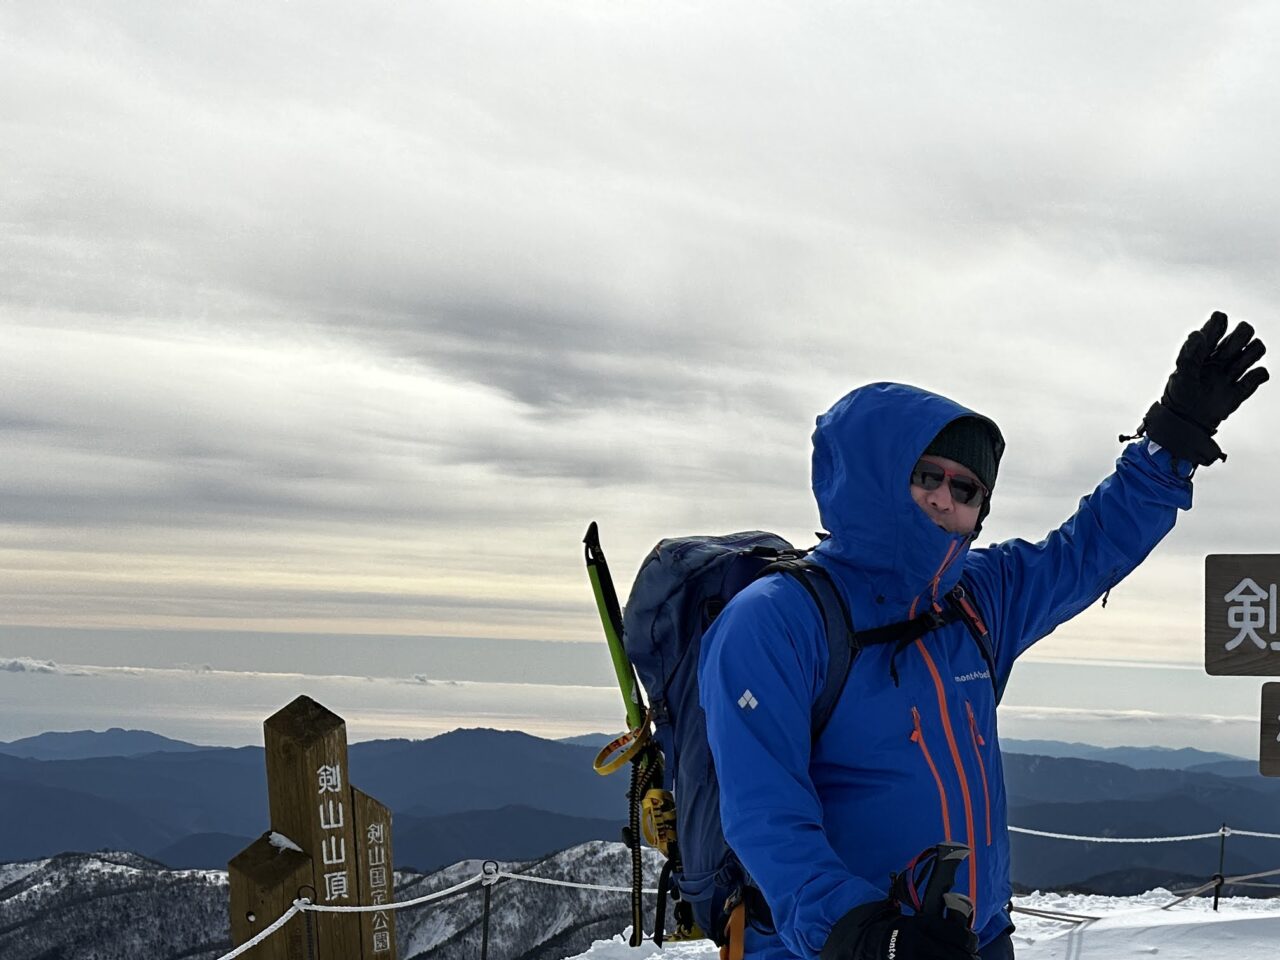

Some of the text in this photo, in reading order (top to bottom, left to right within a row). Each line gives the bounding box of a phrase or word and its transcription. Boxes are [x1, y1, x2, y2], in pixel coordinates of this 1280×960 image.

[317, 764, 349, 901] 剣山山頂
[367, 823, 390, 953] 剣山国定公園
